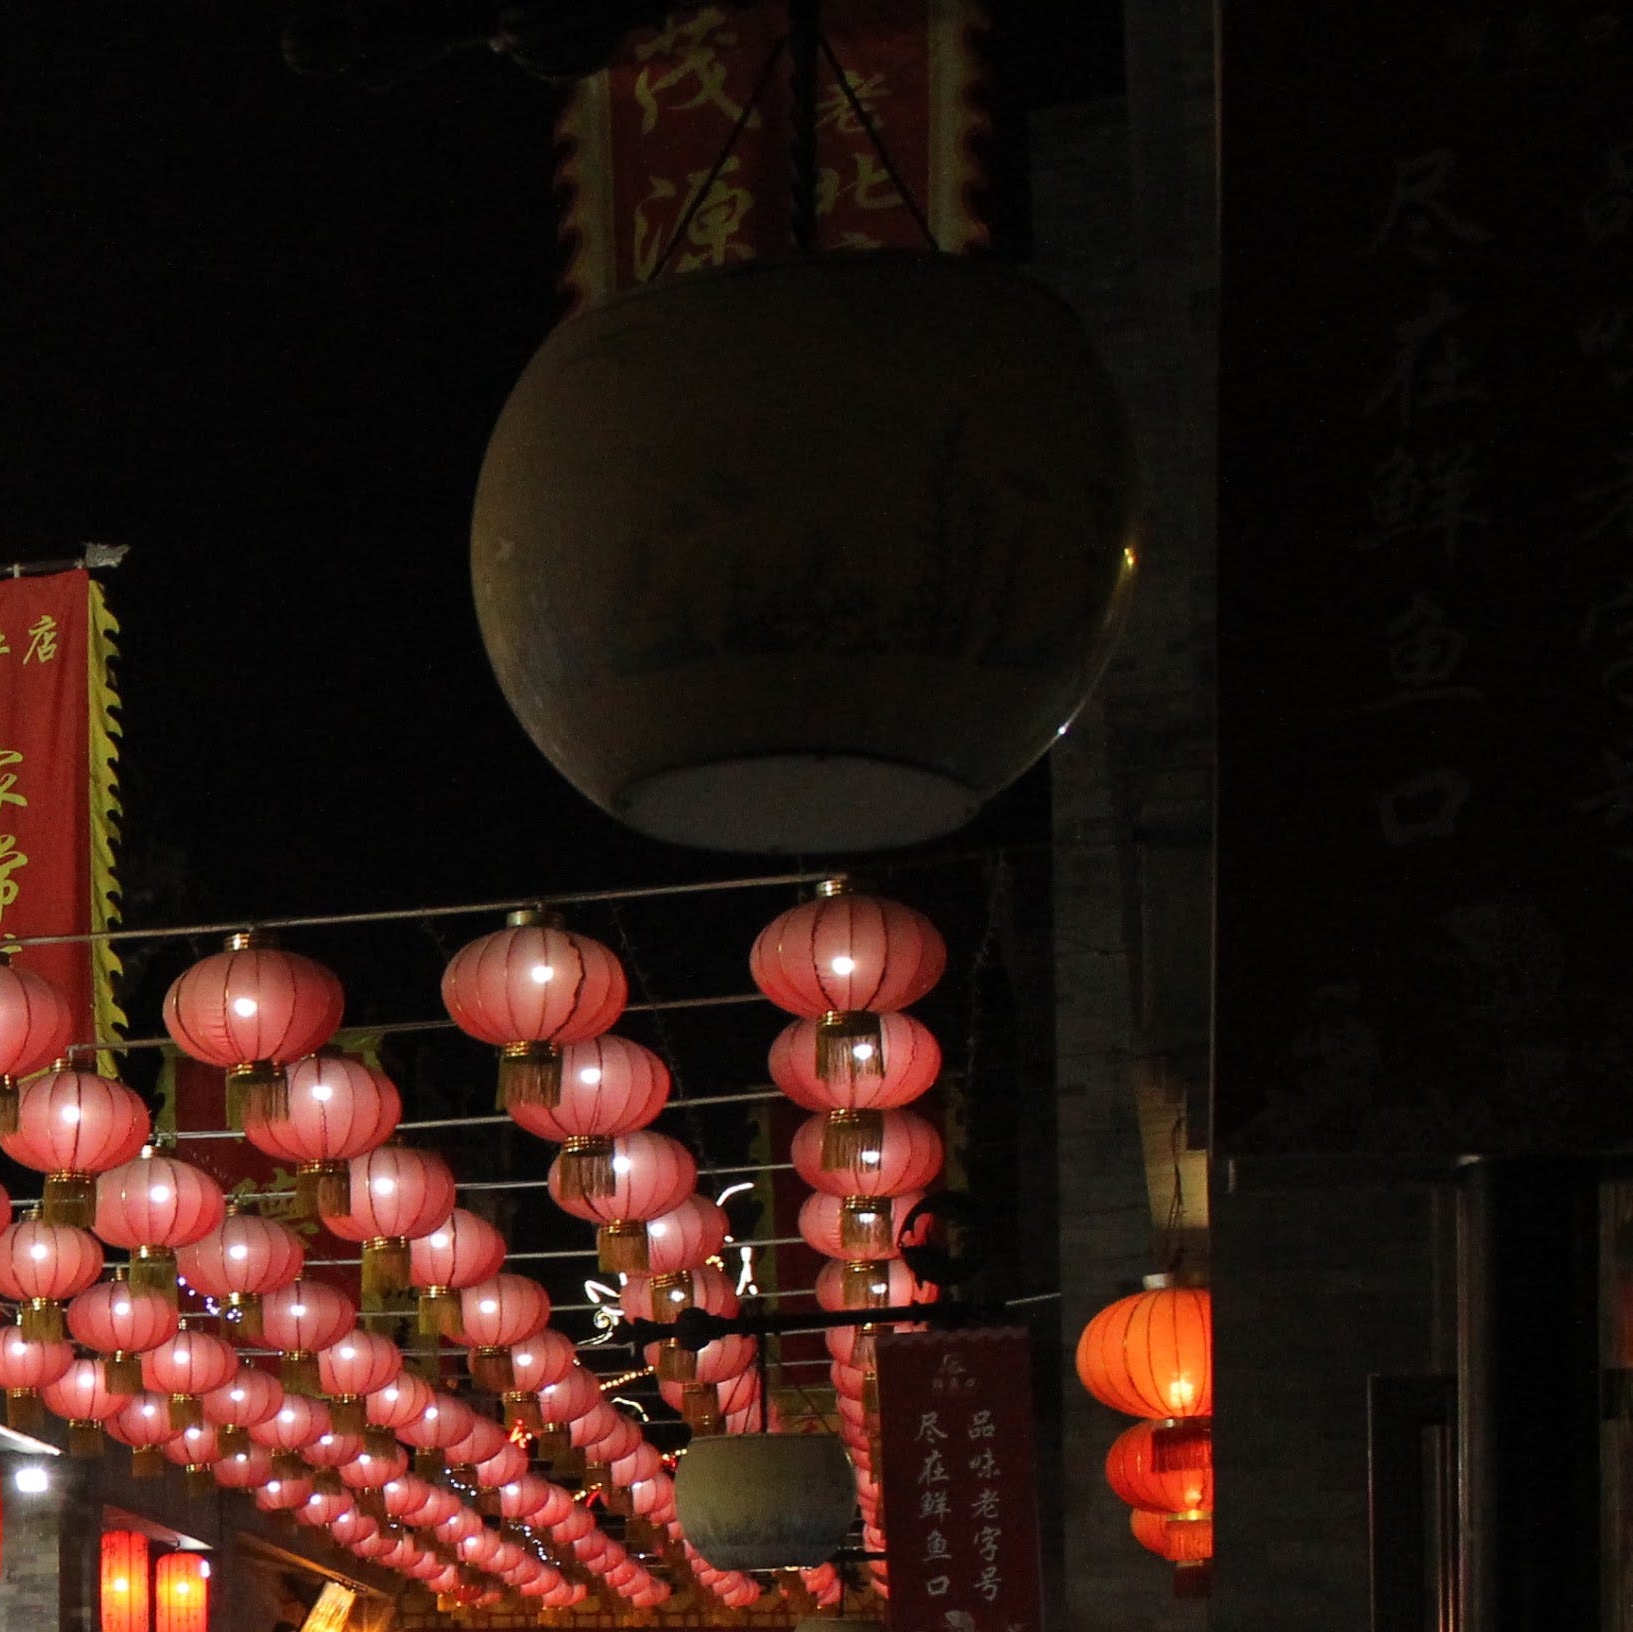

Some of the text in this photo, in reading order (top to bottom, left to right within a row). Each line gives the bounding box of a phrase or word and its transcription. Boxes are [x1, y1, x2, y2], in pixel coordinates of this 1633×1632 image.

[913, 1411, 952, 1598] 尽在鲜鱼口
[966, 1410, 1004, 1601] 品味老字号
